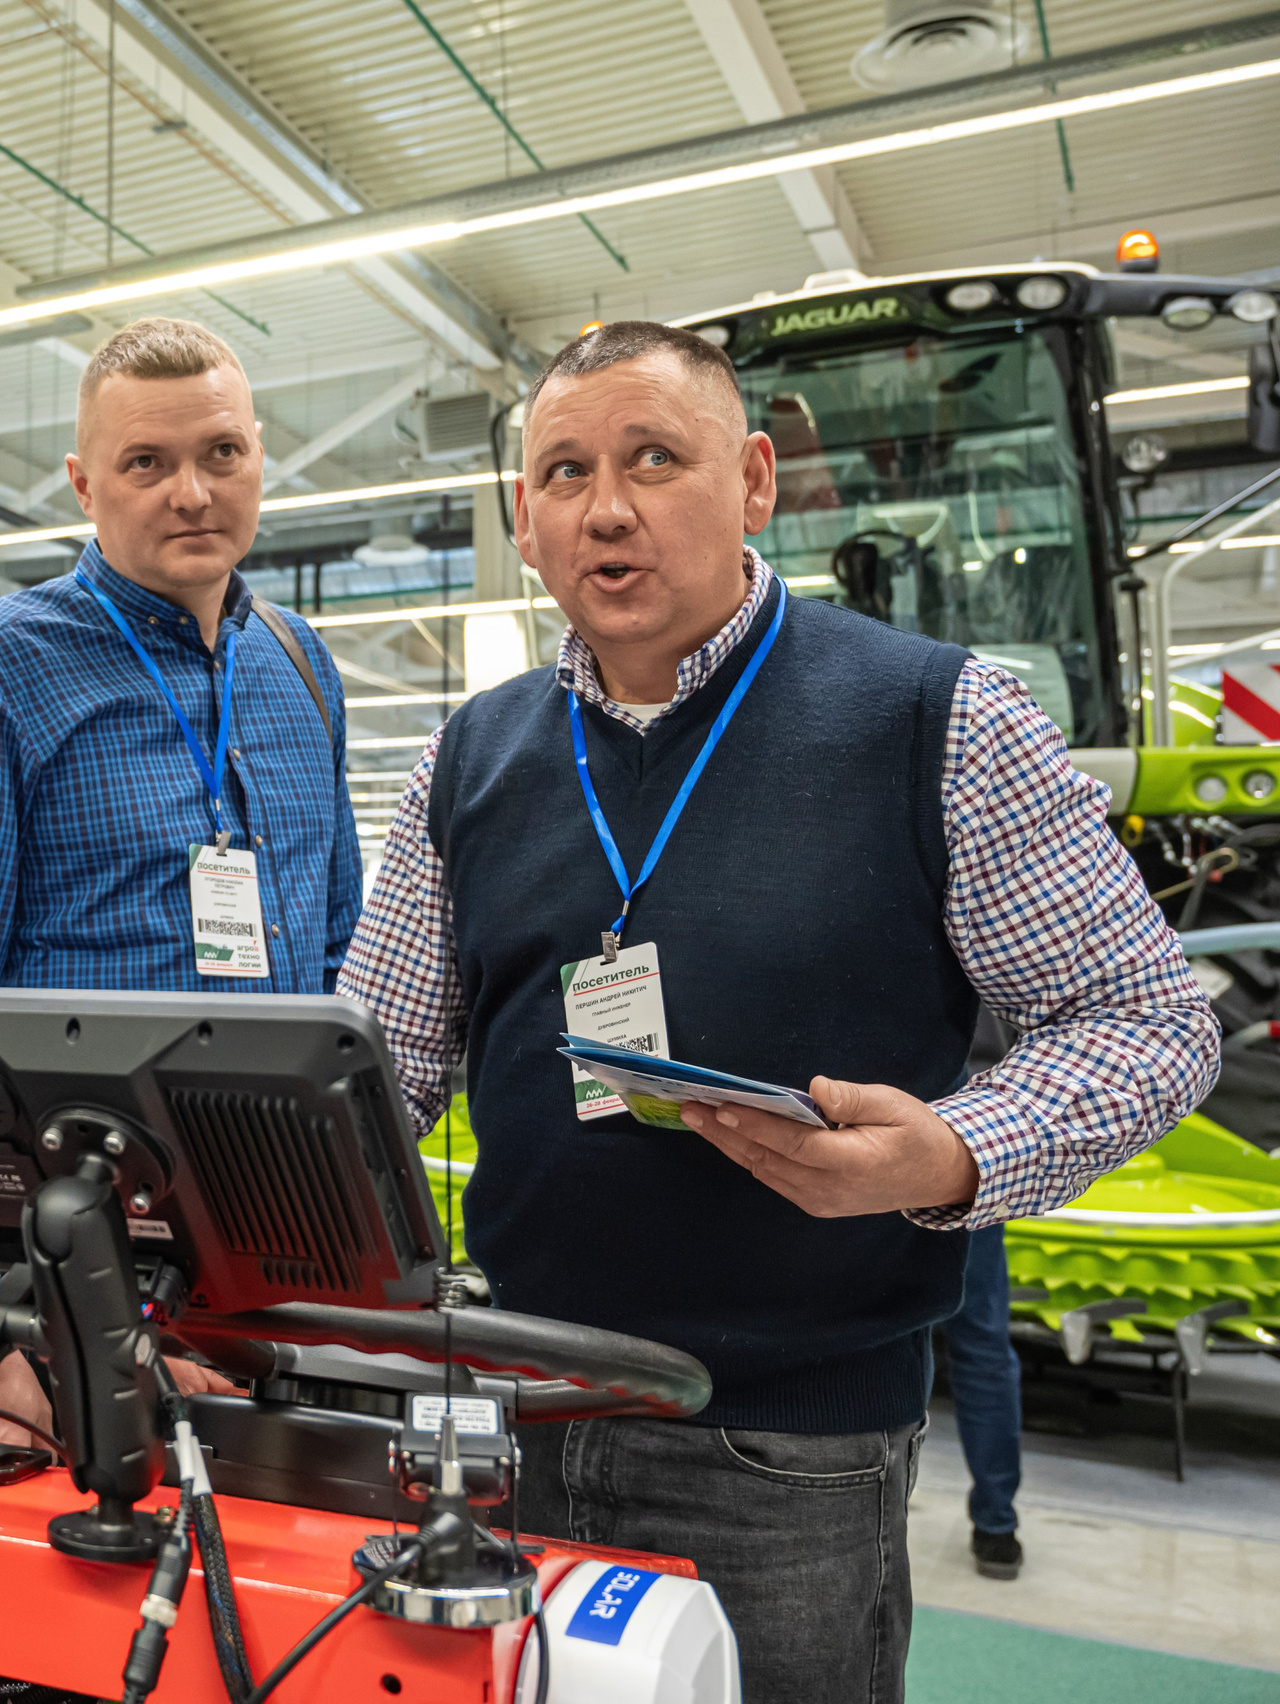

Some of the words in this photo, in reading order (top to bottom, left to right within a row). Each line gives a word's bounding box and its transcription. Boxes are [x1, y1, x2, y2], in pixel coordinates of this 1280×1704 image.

[770, 297, 898, 337] JAGUAR
[197, 862, 250, 874] посетитель
[572, 965, 650, 993] посетитель
[575, 999, 599, 1010] ПЕРШИН
[599, 992, 621, 1004] АНДРЕЙ
[621, 985, 647, 997] НИКИТИЧ
[589, 1571, 640, 1619] SOLAR
